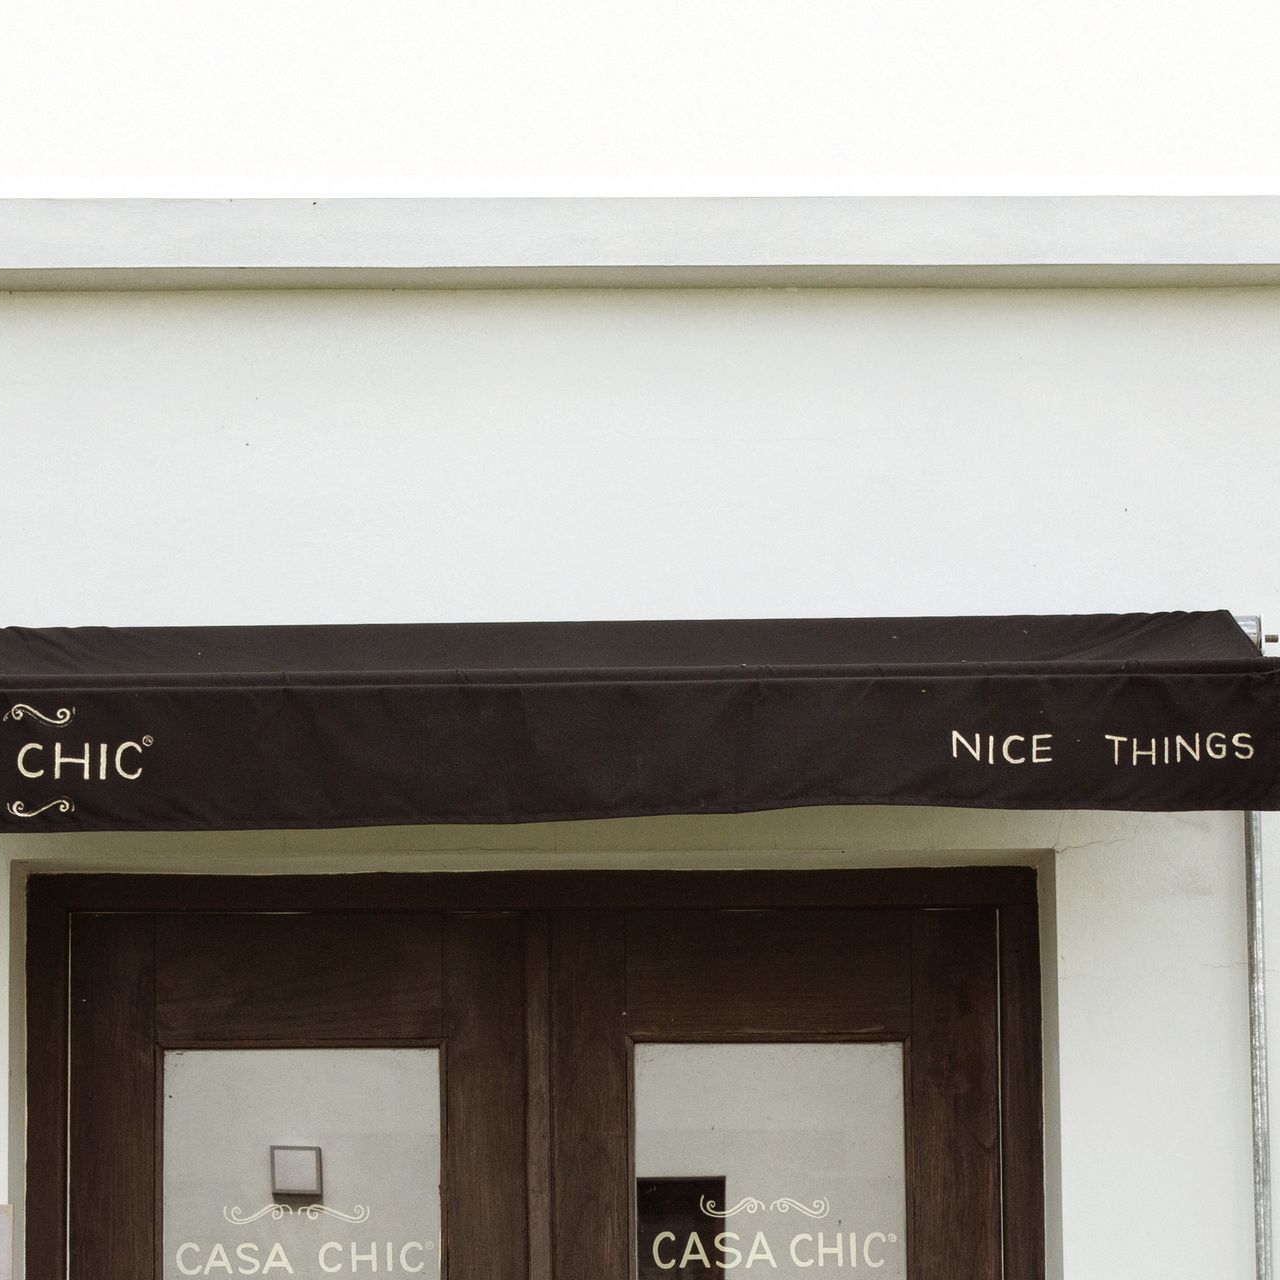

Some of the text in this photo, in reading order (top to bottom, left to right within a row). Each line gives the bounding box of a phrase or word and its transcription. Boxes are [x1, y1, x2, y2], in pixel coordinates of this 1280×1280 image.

[951, 730, 1254, 766] NICE THINGS
[175, 1241, 295, 1276] CASA
[652, 1231, 778, 1269] CASA
